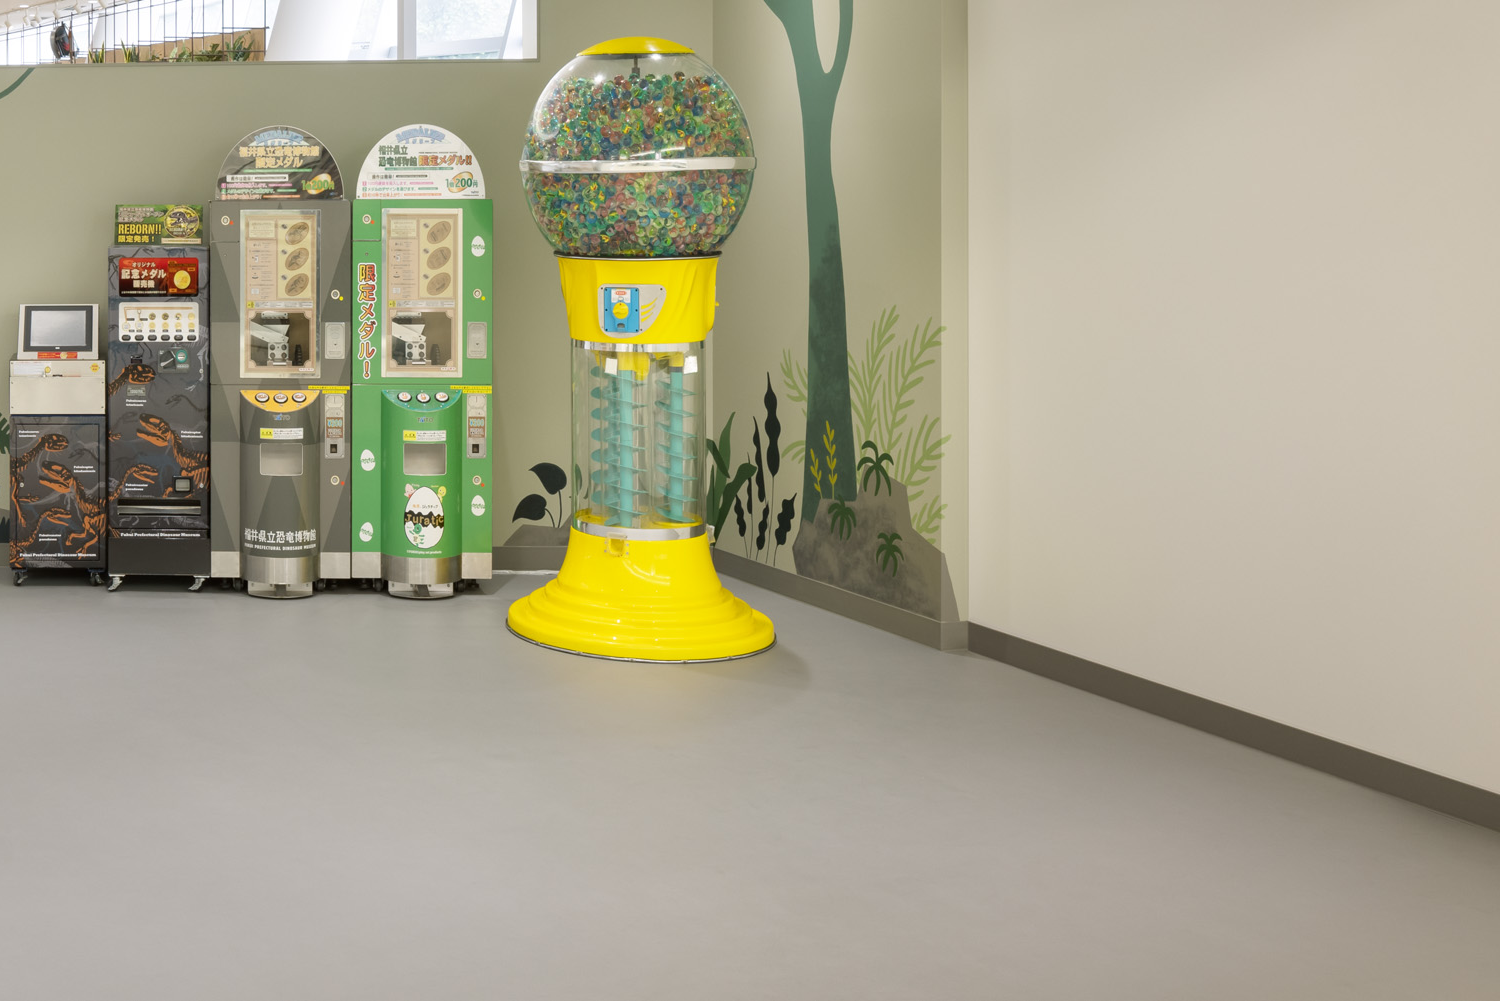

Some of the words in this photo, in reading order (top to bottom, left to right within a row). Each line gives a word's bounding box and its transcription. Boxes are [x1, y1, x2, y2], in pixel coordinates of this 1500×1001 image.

[255, 157, 303, 169] 限定メダル
[118, 223, 162, 235] REBORN!!
[121, 269, 167, 279] 記念メダル
[404, 513, 444, 527] Juratic
[244, 527, 317, 544] 福井県立恐竜博物館
